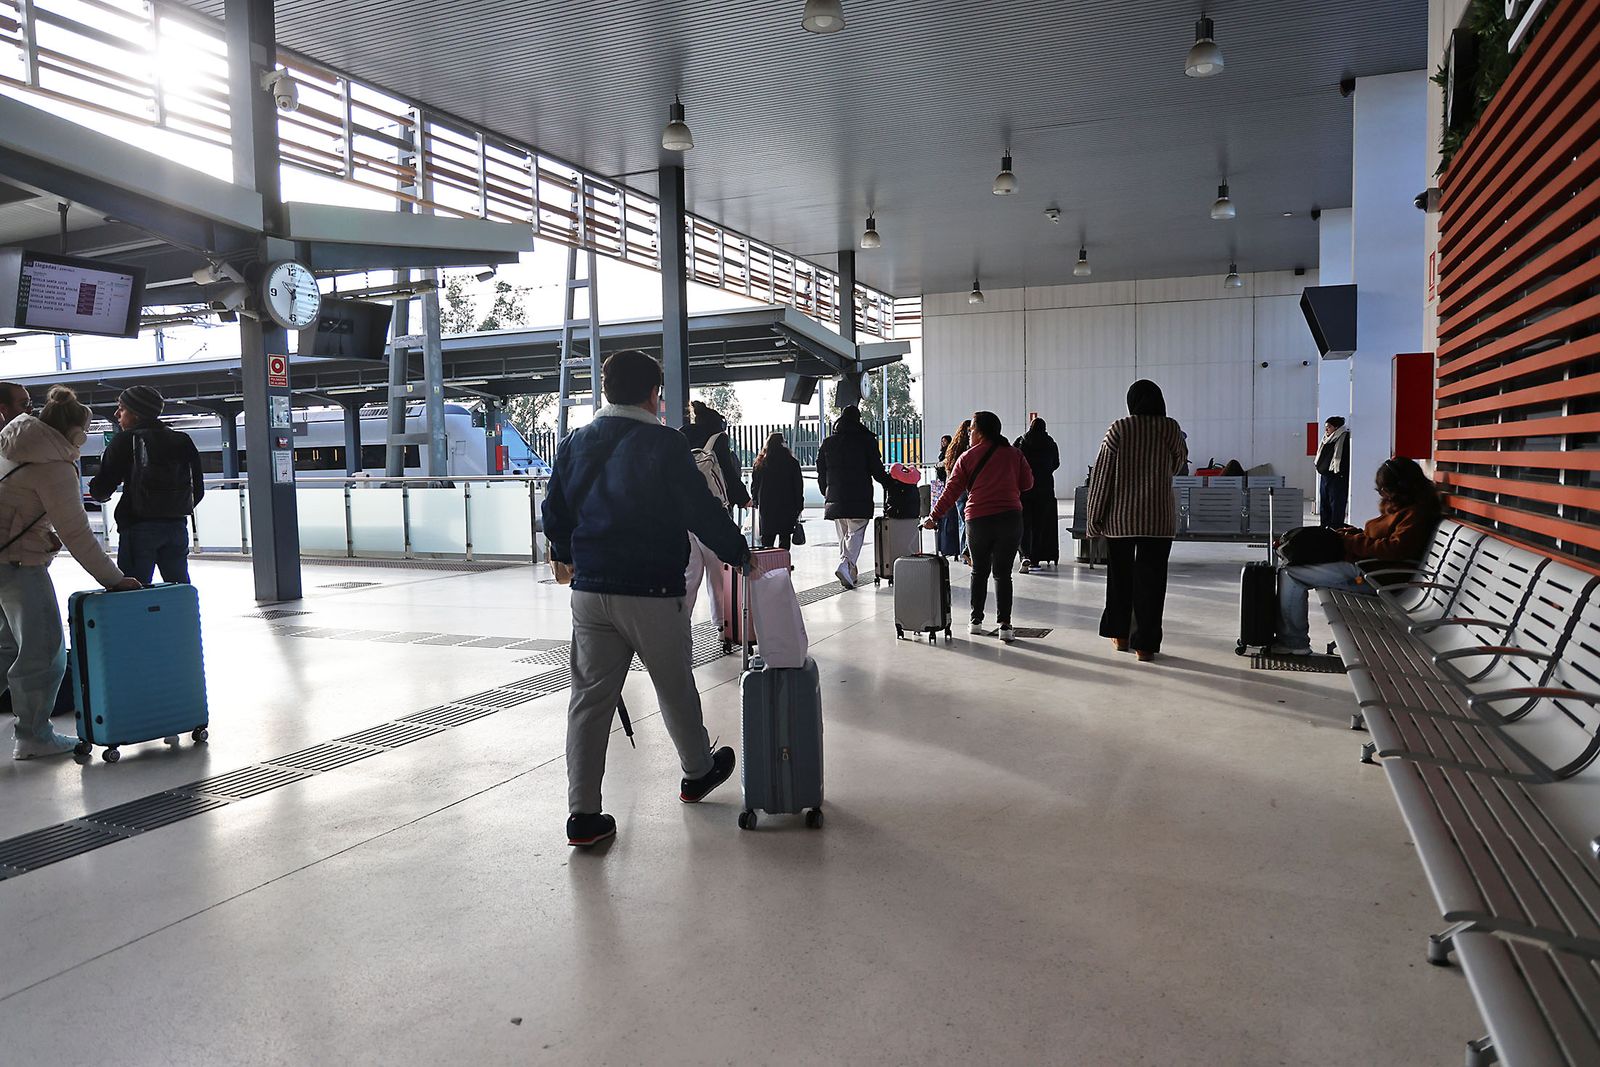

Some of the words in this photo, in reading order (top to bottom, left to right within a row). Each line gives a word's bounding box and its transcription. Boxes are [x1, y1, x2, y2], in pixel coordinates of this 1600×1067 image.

[287, 268, 296, 277] 12
[270, 288, 277, 296] 9
[290, 314, 297, 322] 6
